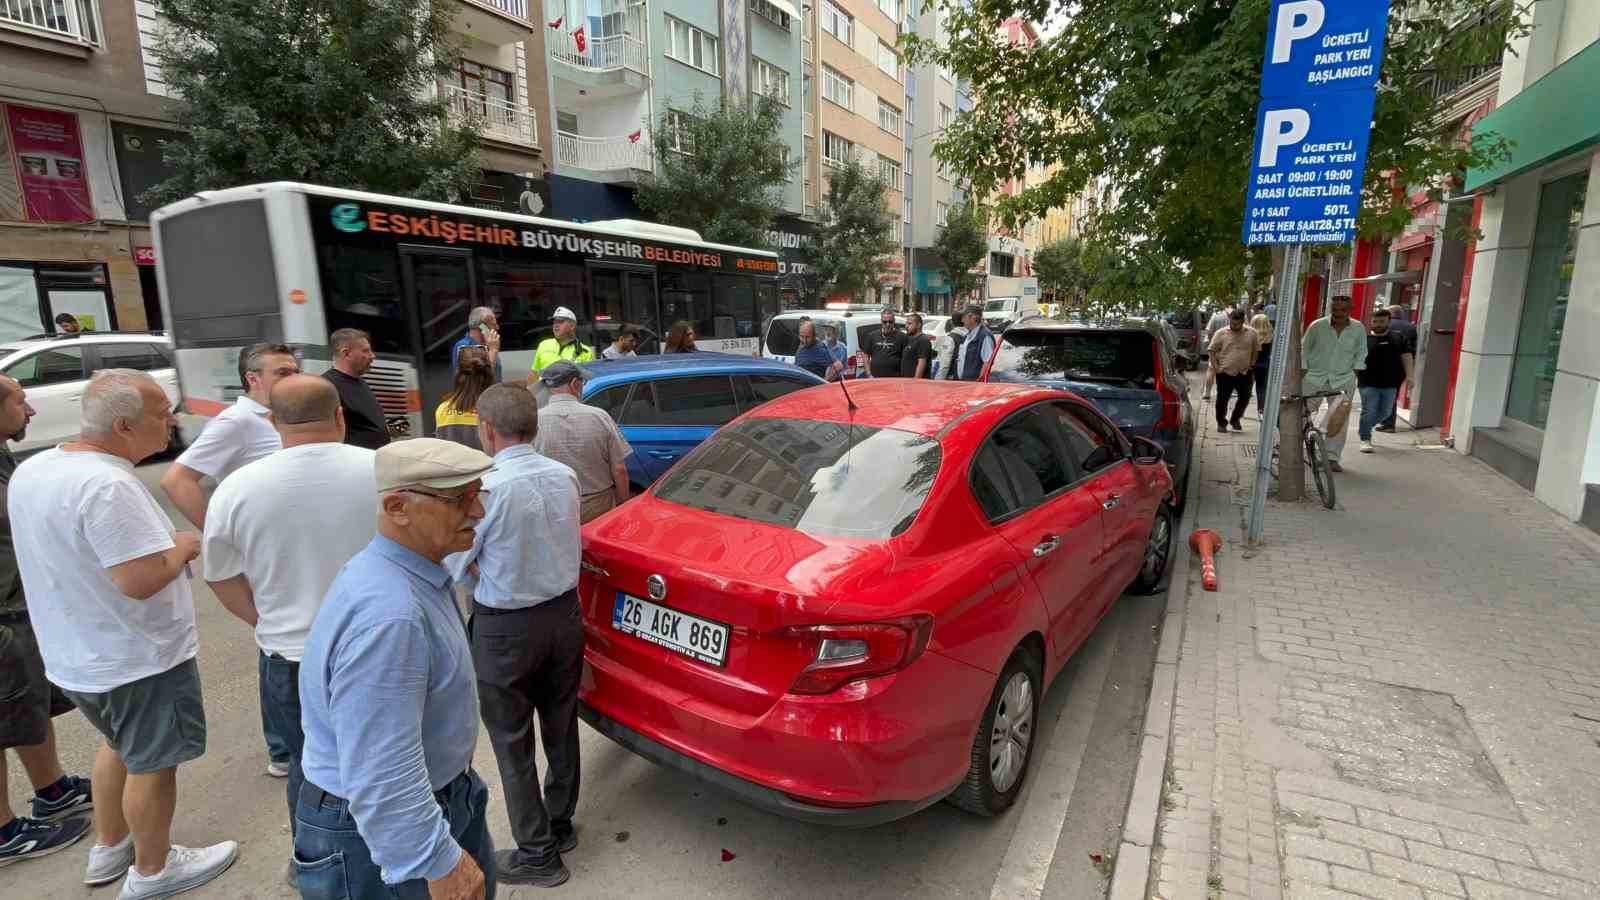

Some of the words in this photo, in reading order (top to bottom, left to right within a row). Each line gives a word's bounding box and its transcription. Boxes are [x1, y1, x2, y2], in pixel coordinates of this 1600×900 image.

[1272, 0, 1325, 64] P
[1322, 29, 1369, 48] ÜCRETLİ
[1314, 52, 1343, 65] PARK
[1345, 46, 1371, 61] YERİ
[1308, 65, 1373, 84] BAŞLANGICI
[1258, 108, 1310, 168] P
[1302, 140, 1352, 153] ÜCRETLİ
[1295, 155, 1325, 165] PARK
[1329, 152, 1357, 163] YERİ
[1257, 173, 1283, 184] SAAT
[1288, 171, 1315, 182] 09:00
[1324, 169, 1353, 180] 19:00
[1254, 188, 1285, 199] ARASI
[1288, 183, 1353, 198] ÜCRETLİDİR.
[1252, 208, 1265, 217] 0-1
[1267, 206, 1290, 217] SAAT
[1251, 220, 1275, 231] İLAVE
[1277, 221, 1295, 231] HER
[367, 211, 519, 246] ESKİŞEHİR
[522, 230, 643, 258] BÜYÜKŞEHİR
[645, 246, 721, 268] BELEDİYESİ
[1279, 233, 1298, 242] Arası
[624, 599, 642, 626] 26
[651, 609, 682, 641] AGK
[689, 623, 722, 654] 869
